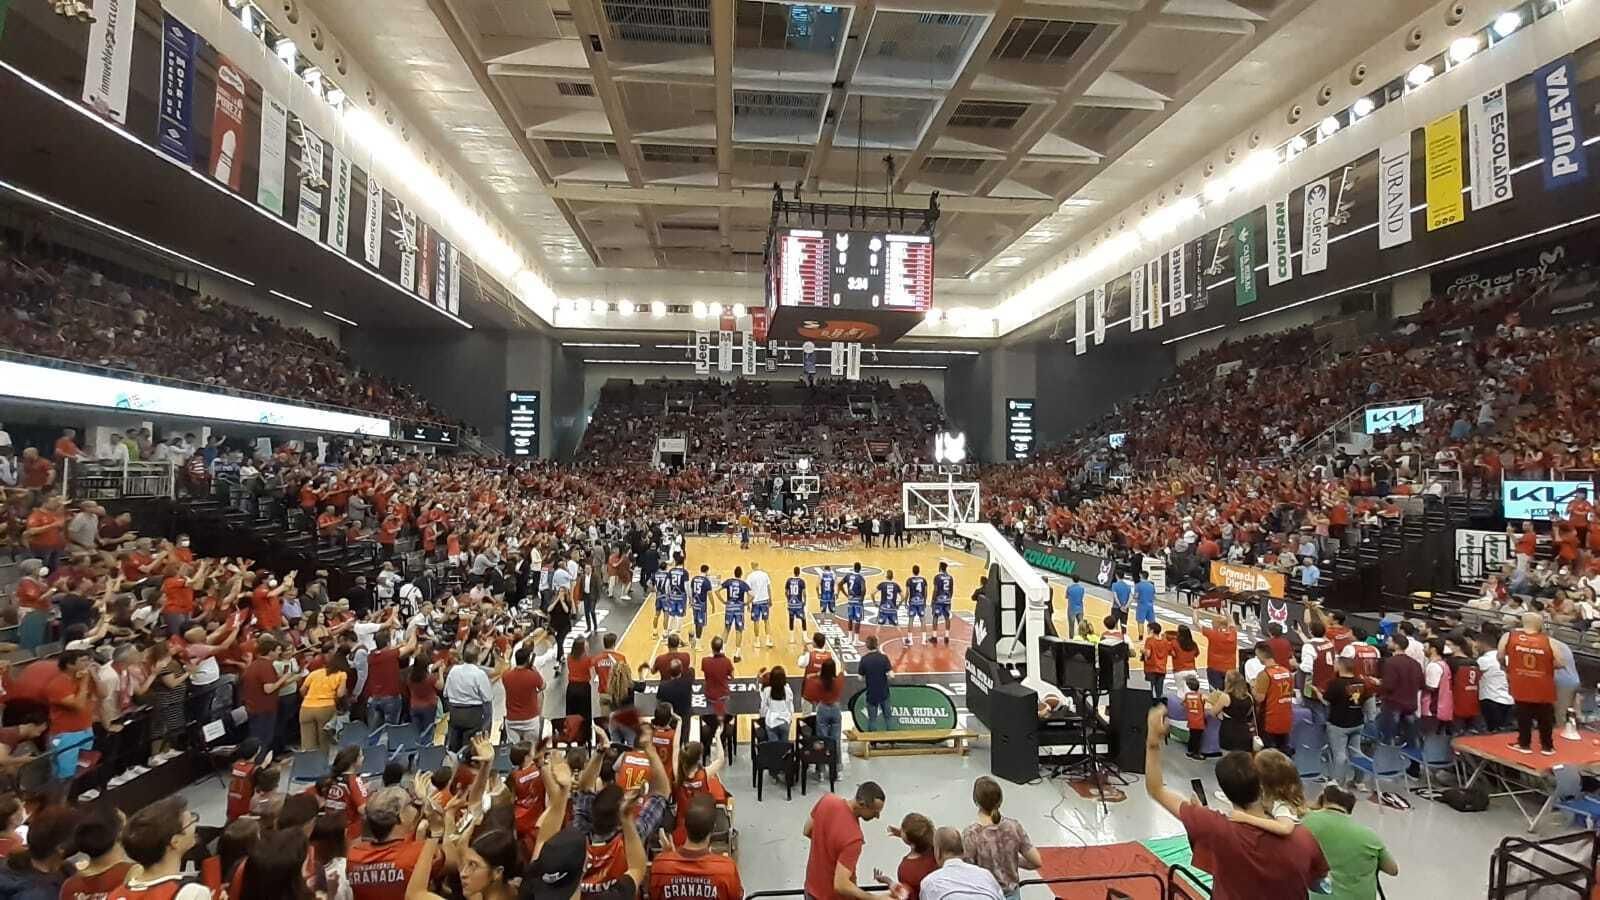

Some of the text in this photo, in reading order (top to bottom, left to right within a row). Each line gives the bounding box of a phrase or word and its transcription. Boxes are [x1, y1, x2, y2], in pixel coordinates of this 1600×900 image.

[1546, 64, 1579, 177] PULEVA
[1382, 154, 1405, 234] JURAND
[1311, 206, 1325, 256] Cuerva
[1173, 248, 1181, 298] BERNER
[697, 336, 709, 368] Jeep
[1372, 408, 1417, 423] KIA
[729, 586, 740, 598] 12
[790, 584, 799, 595] 10
[886, 588, 893, 599] 5
[912, 706, 949, 718] RURAL
[899, 717, 937, 725] GRANADA
[664, 883, 718, 899] GRANADA
